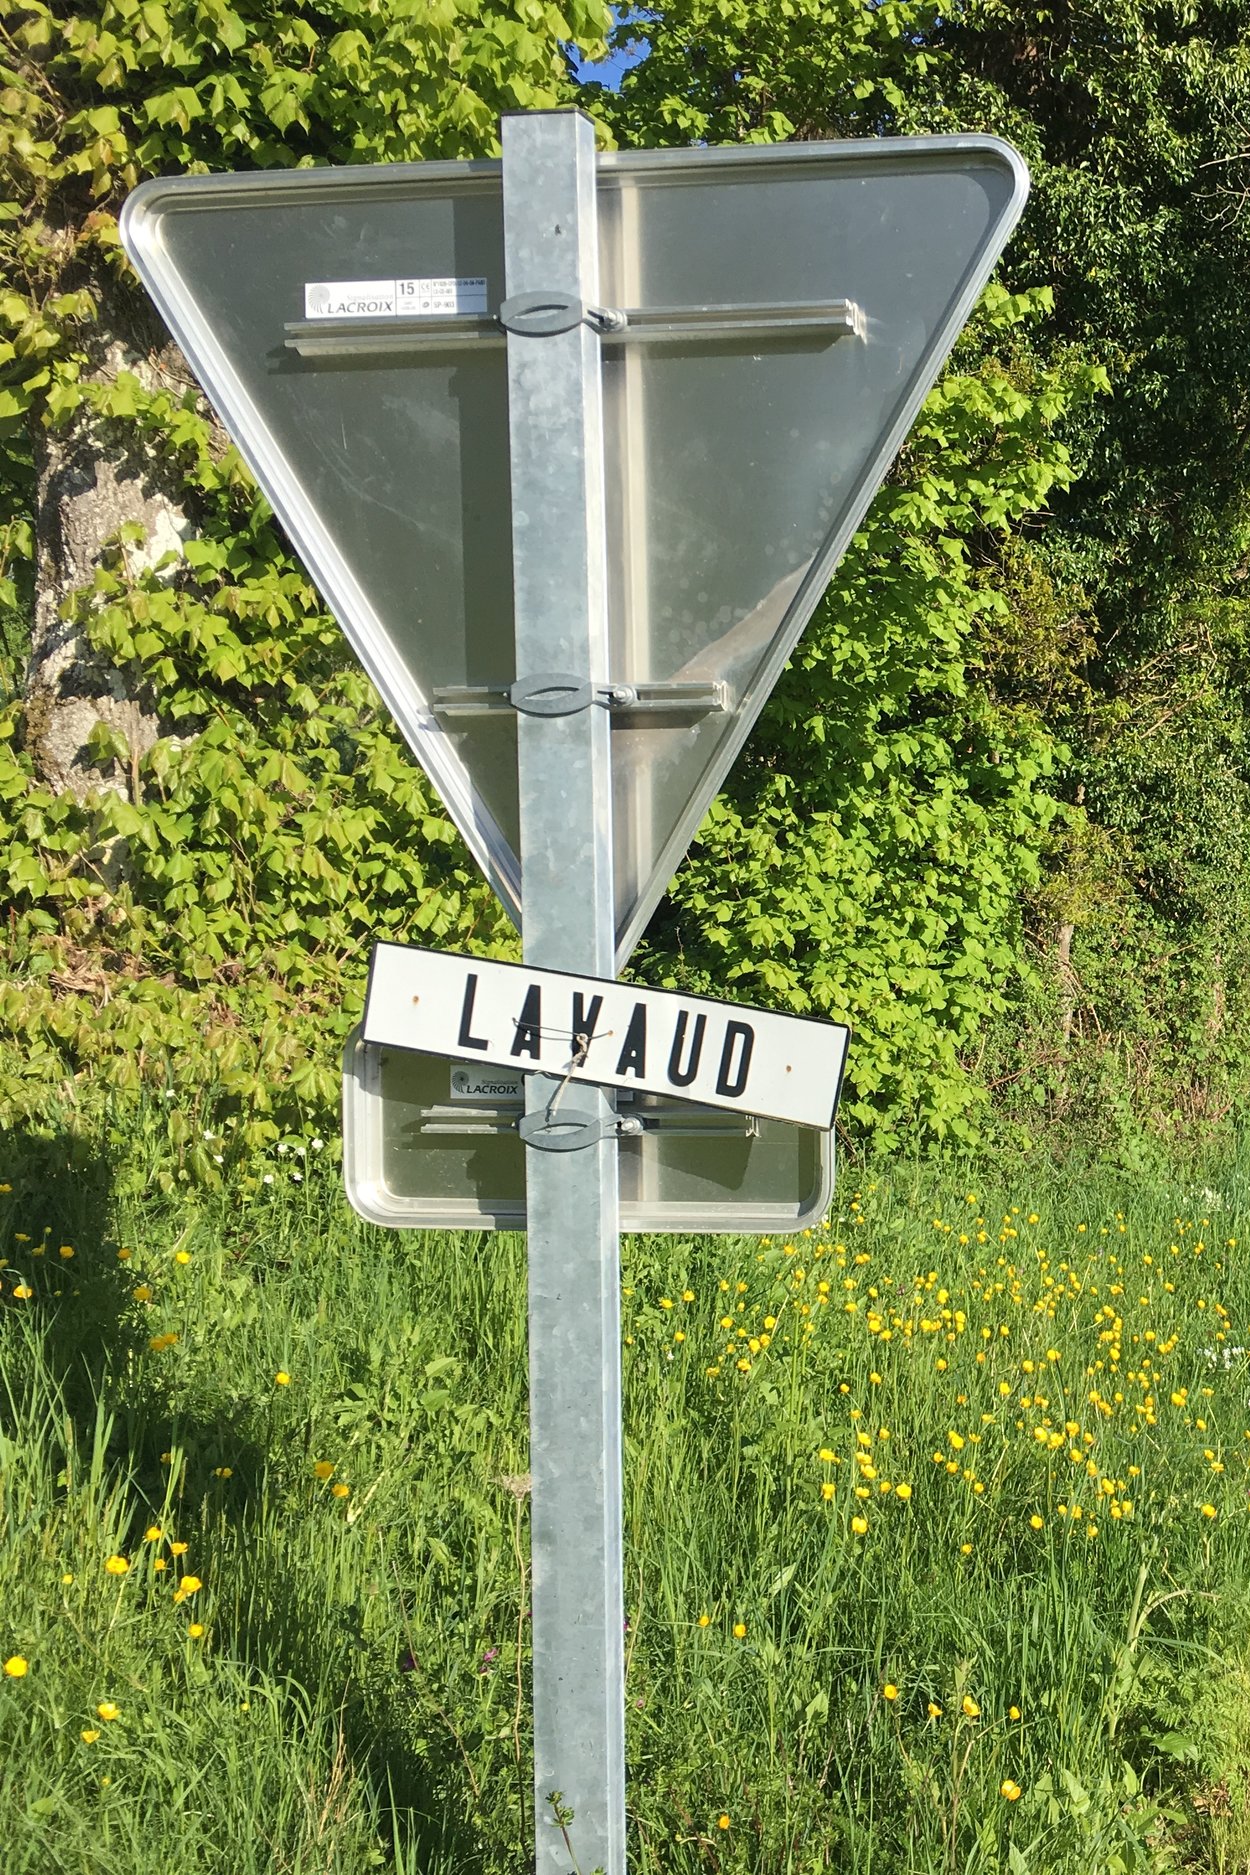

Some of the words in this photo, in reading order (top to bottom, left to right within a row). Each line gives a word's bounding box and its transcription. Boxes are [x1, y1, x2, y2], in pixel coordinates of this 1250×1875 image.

[399, 282, 415, 295] 15
[327, 301, 394, 314] LACROIX
[458, 973, 755, 1098] LAVAUD
[466, 1085, 519, 1095] LACROIX
